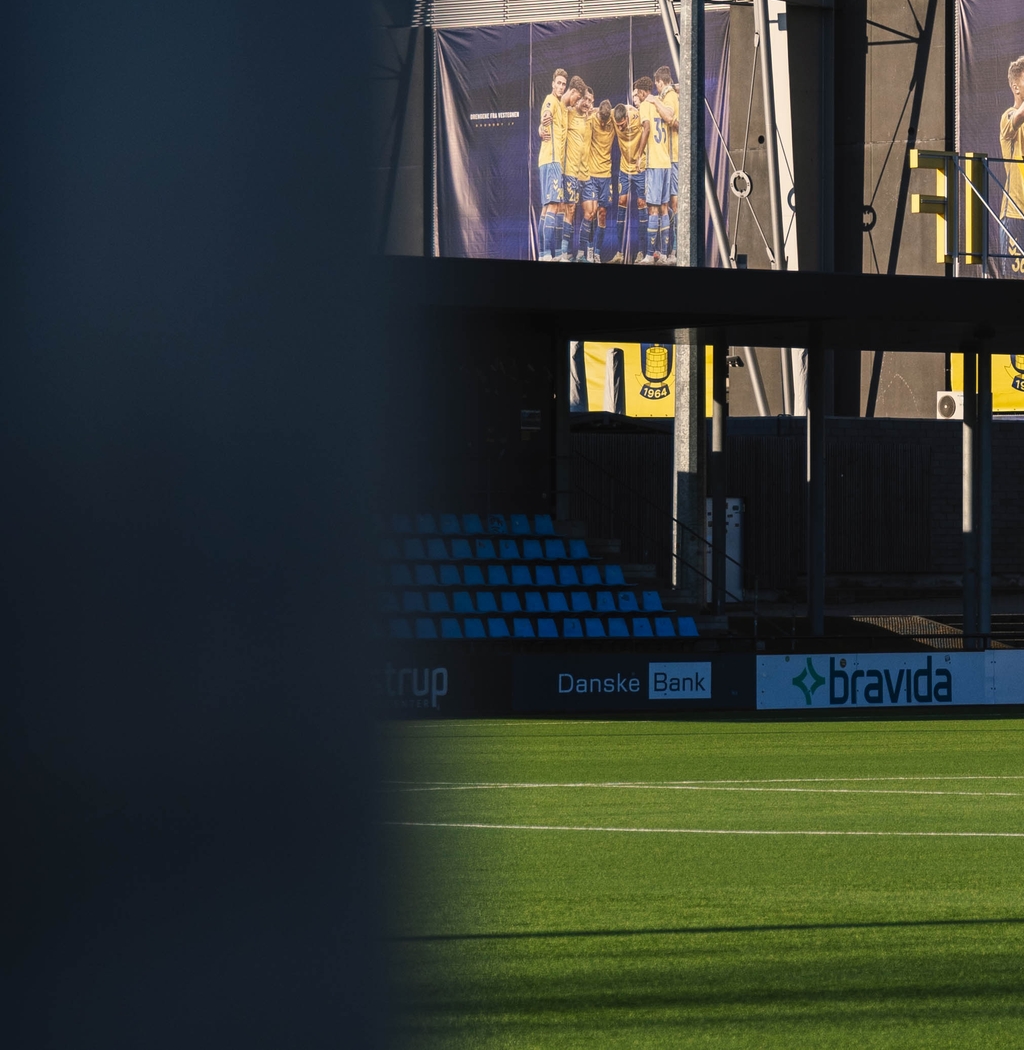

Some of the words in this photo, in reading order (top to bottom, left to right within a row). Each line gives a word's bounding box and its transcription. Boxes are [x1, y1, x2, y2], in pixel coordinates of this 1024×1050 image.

[643, 387, 668, 399] 1964
[558, 672, 640, 694] Danske
[653, 672, 706, 692] Bank
[829, 655, 953, 705] bravida
